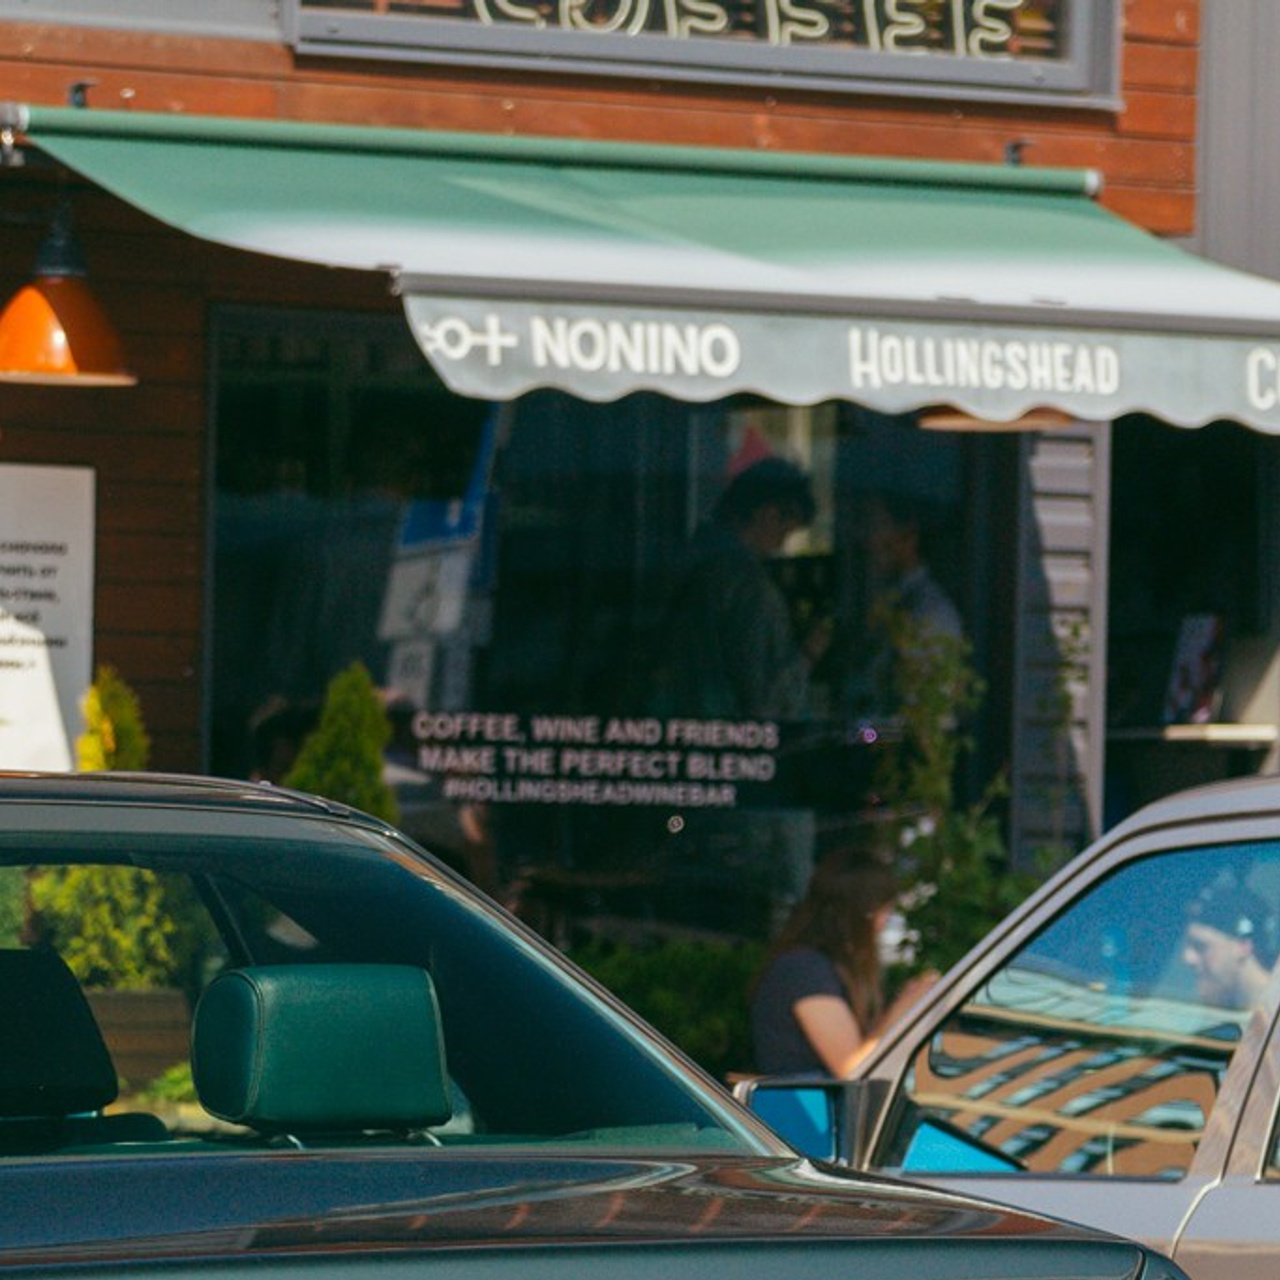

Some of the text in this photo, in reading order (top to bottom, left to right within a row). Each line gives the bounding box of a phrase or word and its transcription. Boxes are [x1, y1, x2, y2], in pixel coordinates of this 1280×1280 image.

[530, 316, 741, 378] NONINO
[848, 327, 1120, 396] HOLLINGSHEAD
[413, 711, 780, 749] COFFEE, WINE AND FRIENDS
[421, 746, 775, 780] MAKE THE PERFECT BLEND
